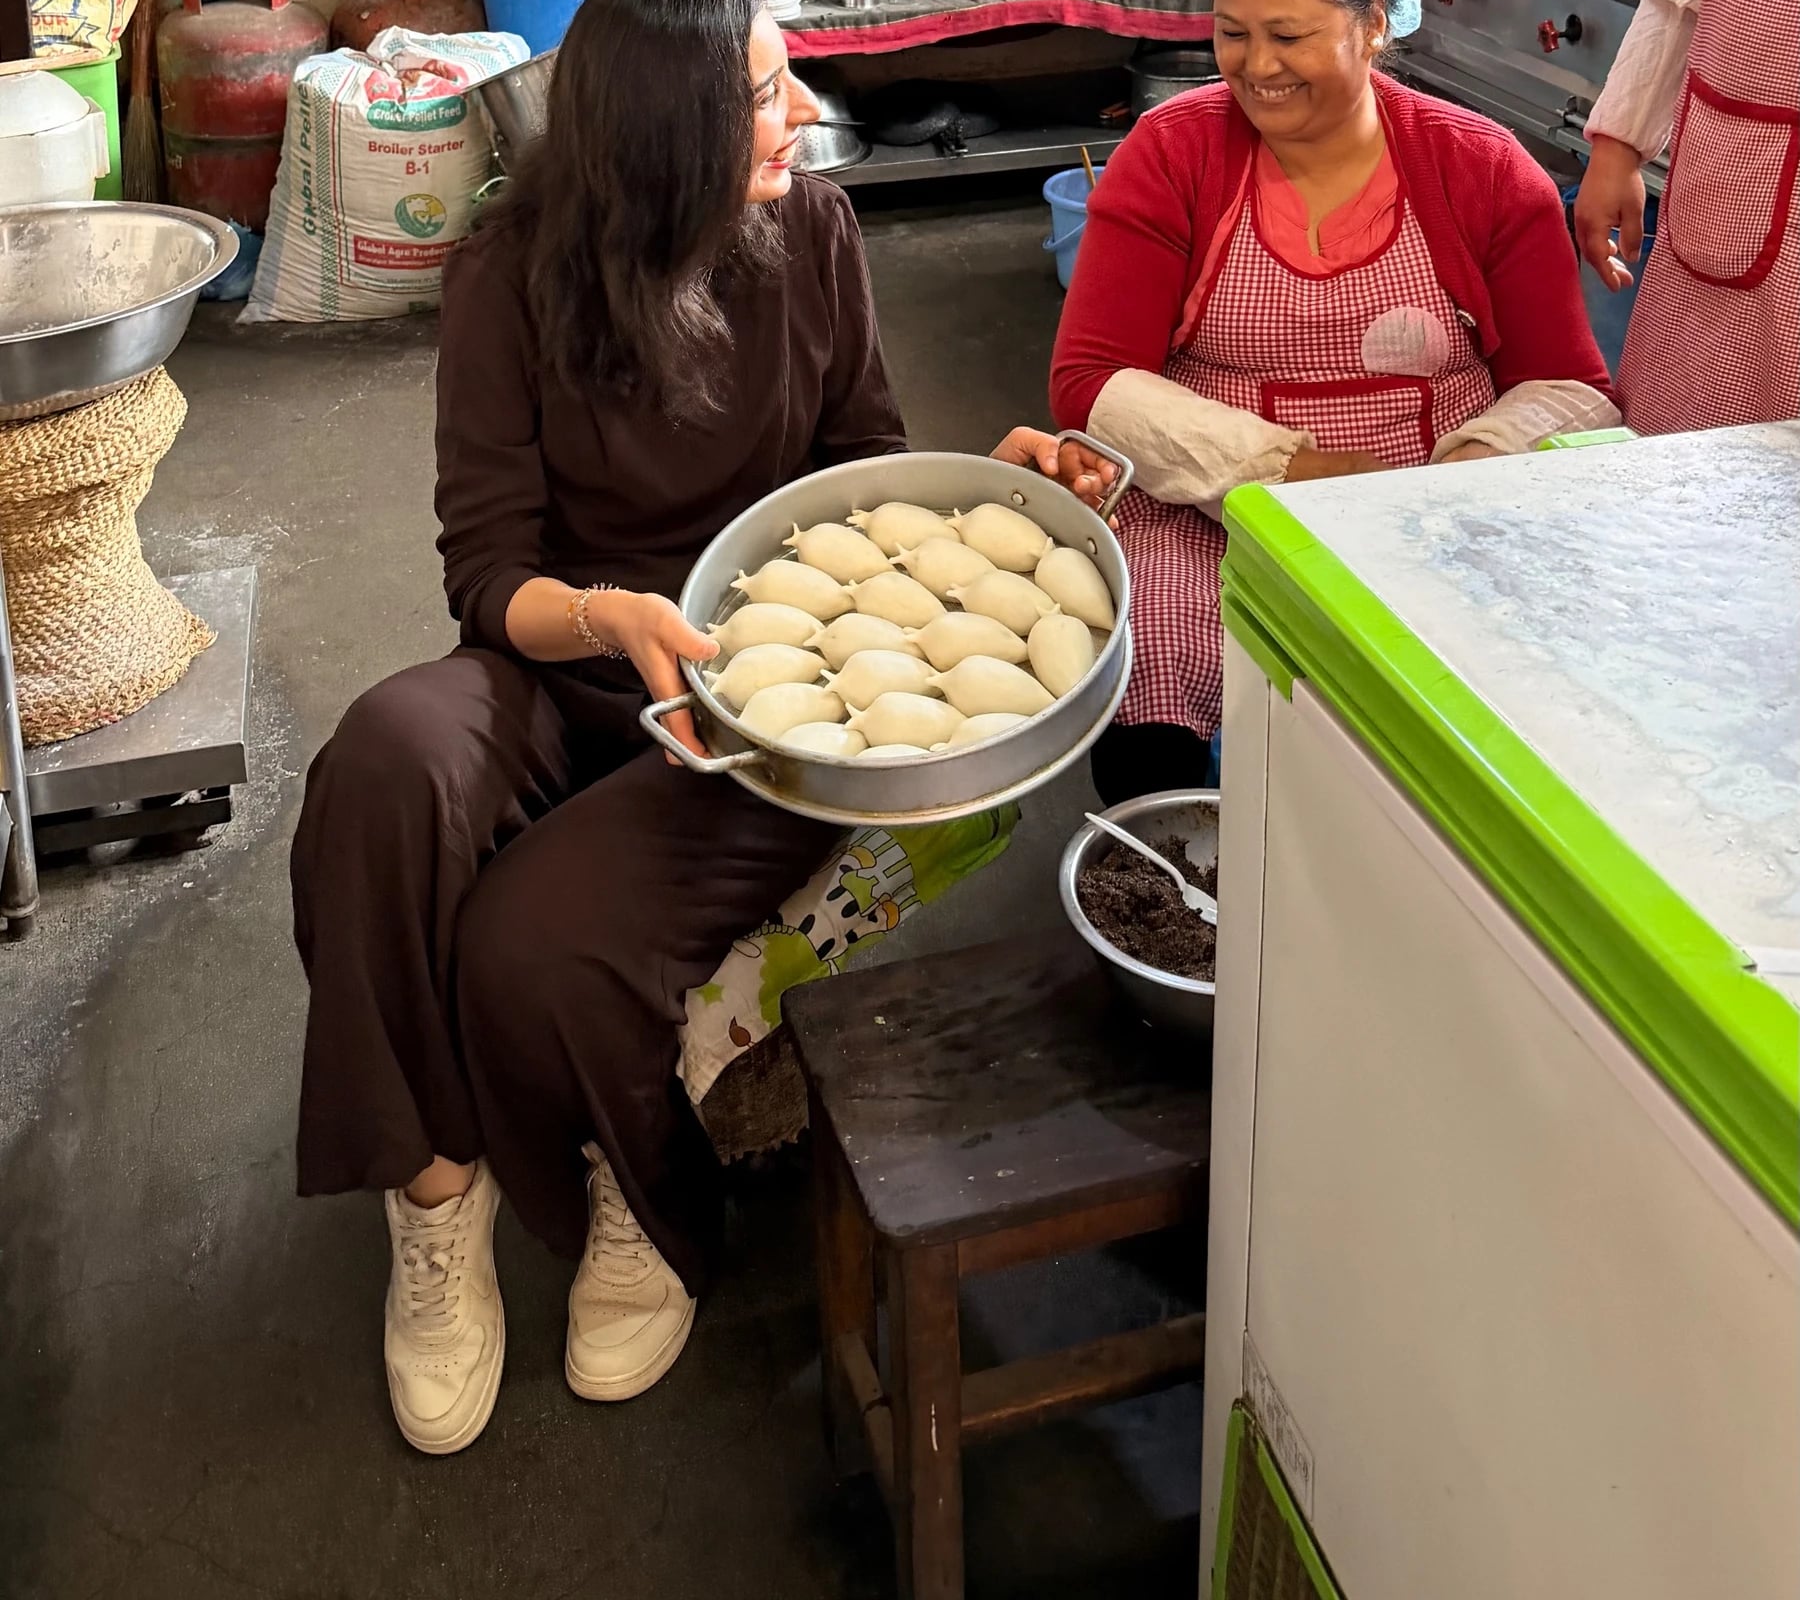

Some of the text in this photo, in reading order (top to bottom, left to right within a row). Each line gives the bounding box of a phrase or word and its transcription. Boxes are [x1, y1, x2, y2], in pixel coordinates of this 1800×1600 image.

[438, 104, 462, 120] Feed
[368, 140, 465, 156] Broiler Starter
[405, 160, 430, 175] B-1
[357, 240, 386, 255] Global
[387, 247, 410, 259] Agro
